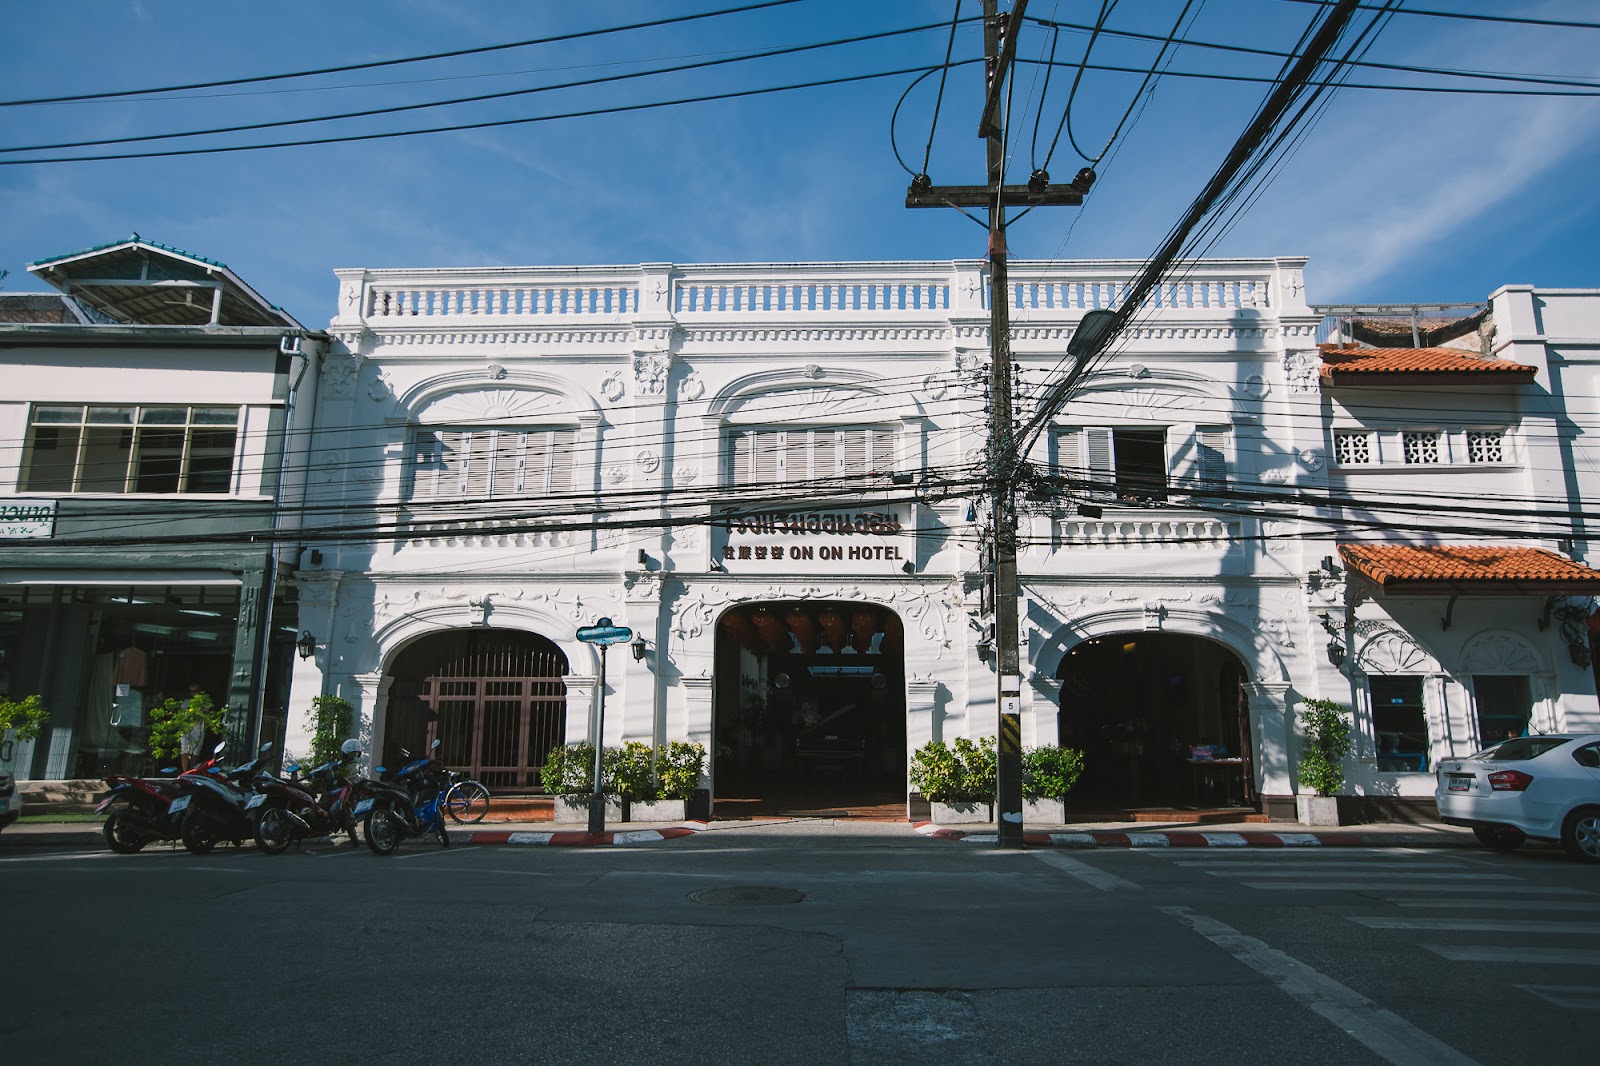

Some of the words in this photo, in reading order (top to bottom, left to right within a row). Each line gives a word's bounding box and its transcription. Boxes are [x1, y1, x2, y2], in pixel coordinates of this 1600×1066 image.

[789, 546, 814, 561] ON
[819, 546, 843, 561] ON
[848, 546, 903, 561] HOTEL
[1008, 702, 1014, 710] 5
